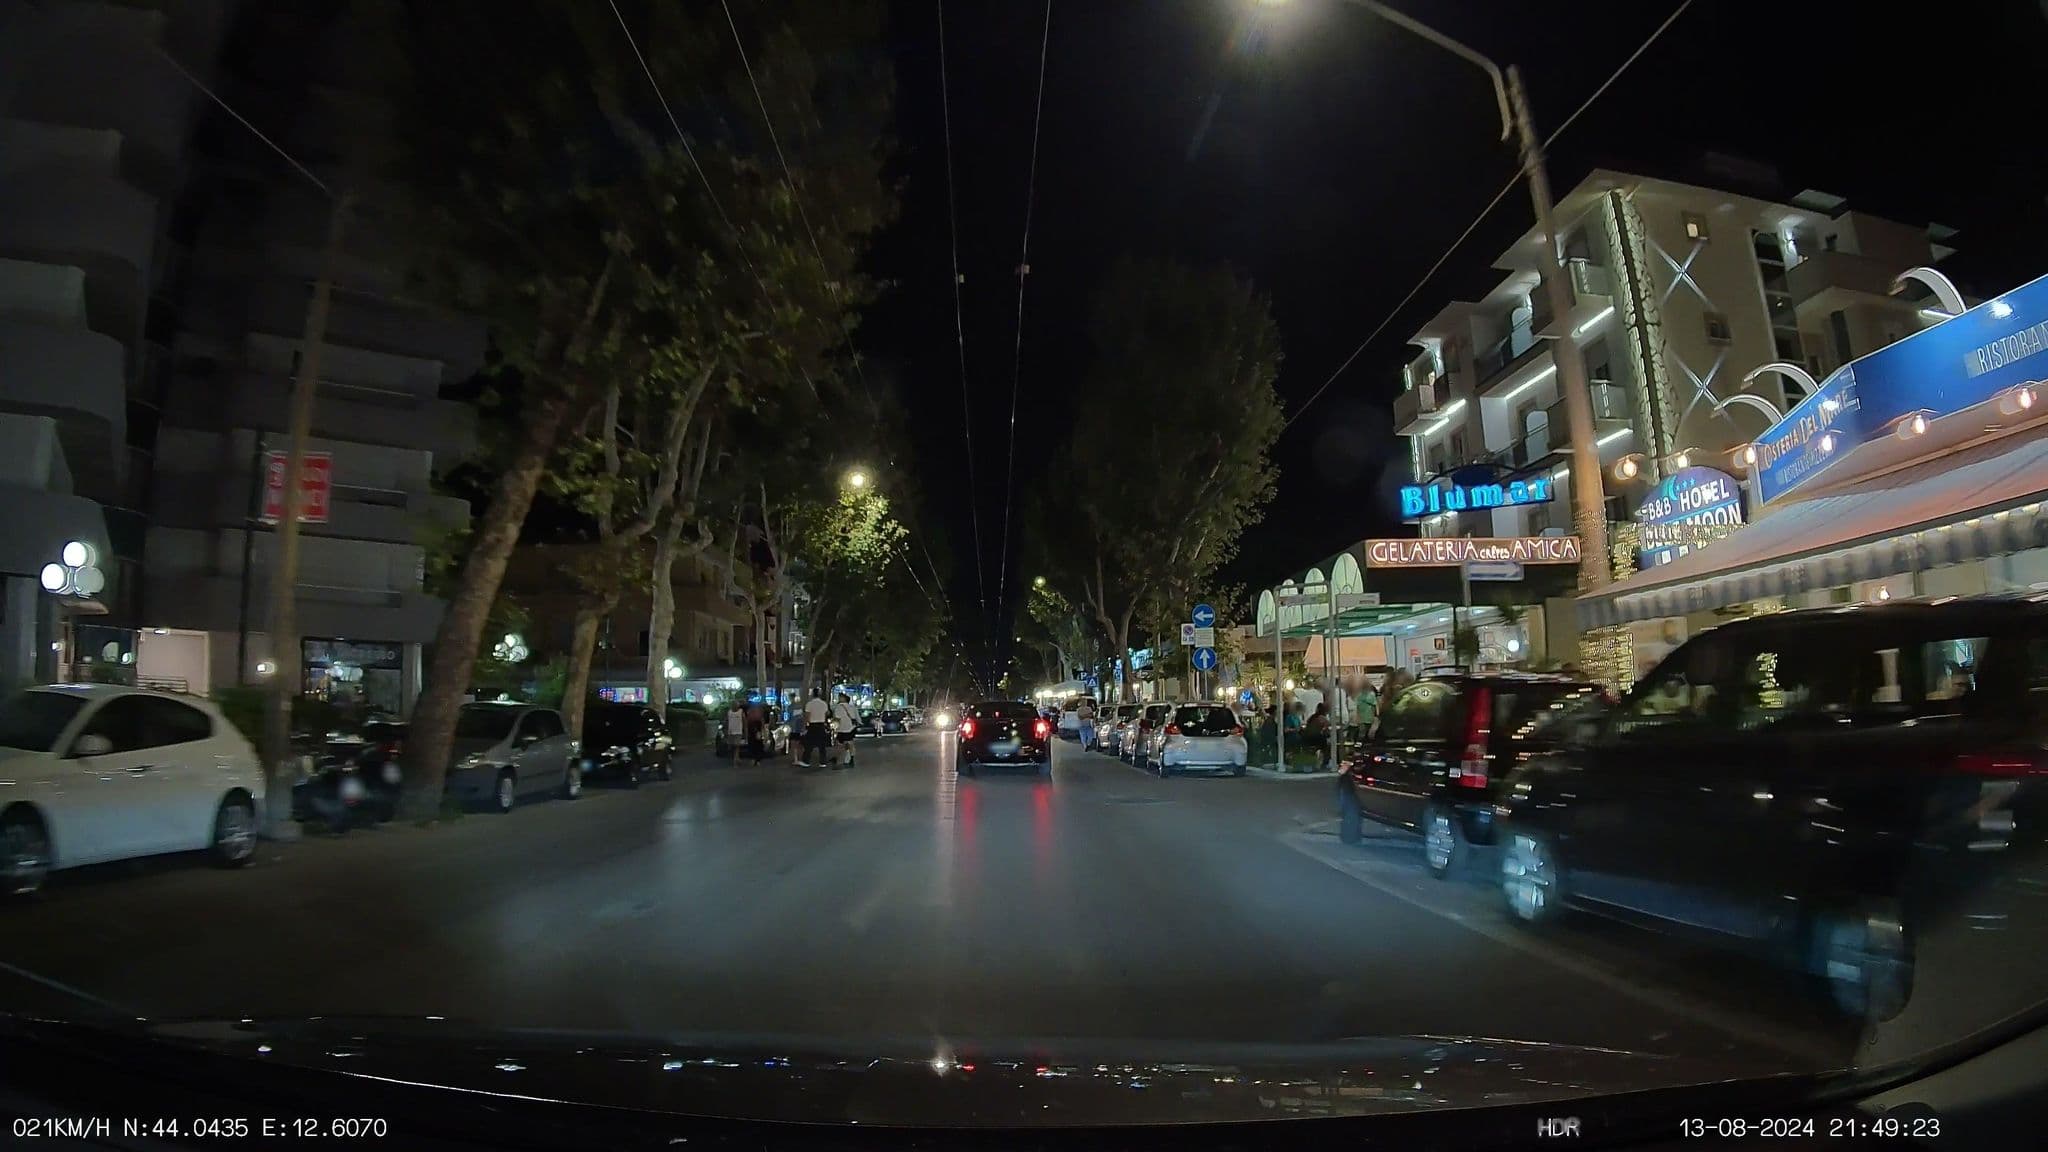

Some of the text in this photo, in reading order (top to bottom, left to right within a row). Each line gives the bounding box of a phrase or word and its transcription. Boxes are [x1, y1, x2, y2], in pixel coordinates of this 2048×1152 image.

[1400, 478, 1550, 518] Blumar
[1648, 478, 1730, 520] B&B HOTEL
[1372, 541, 1479, 561] GELATERIA
[1513, 540, 1577, 560] AMICA
